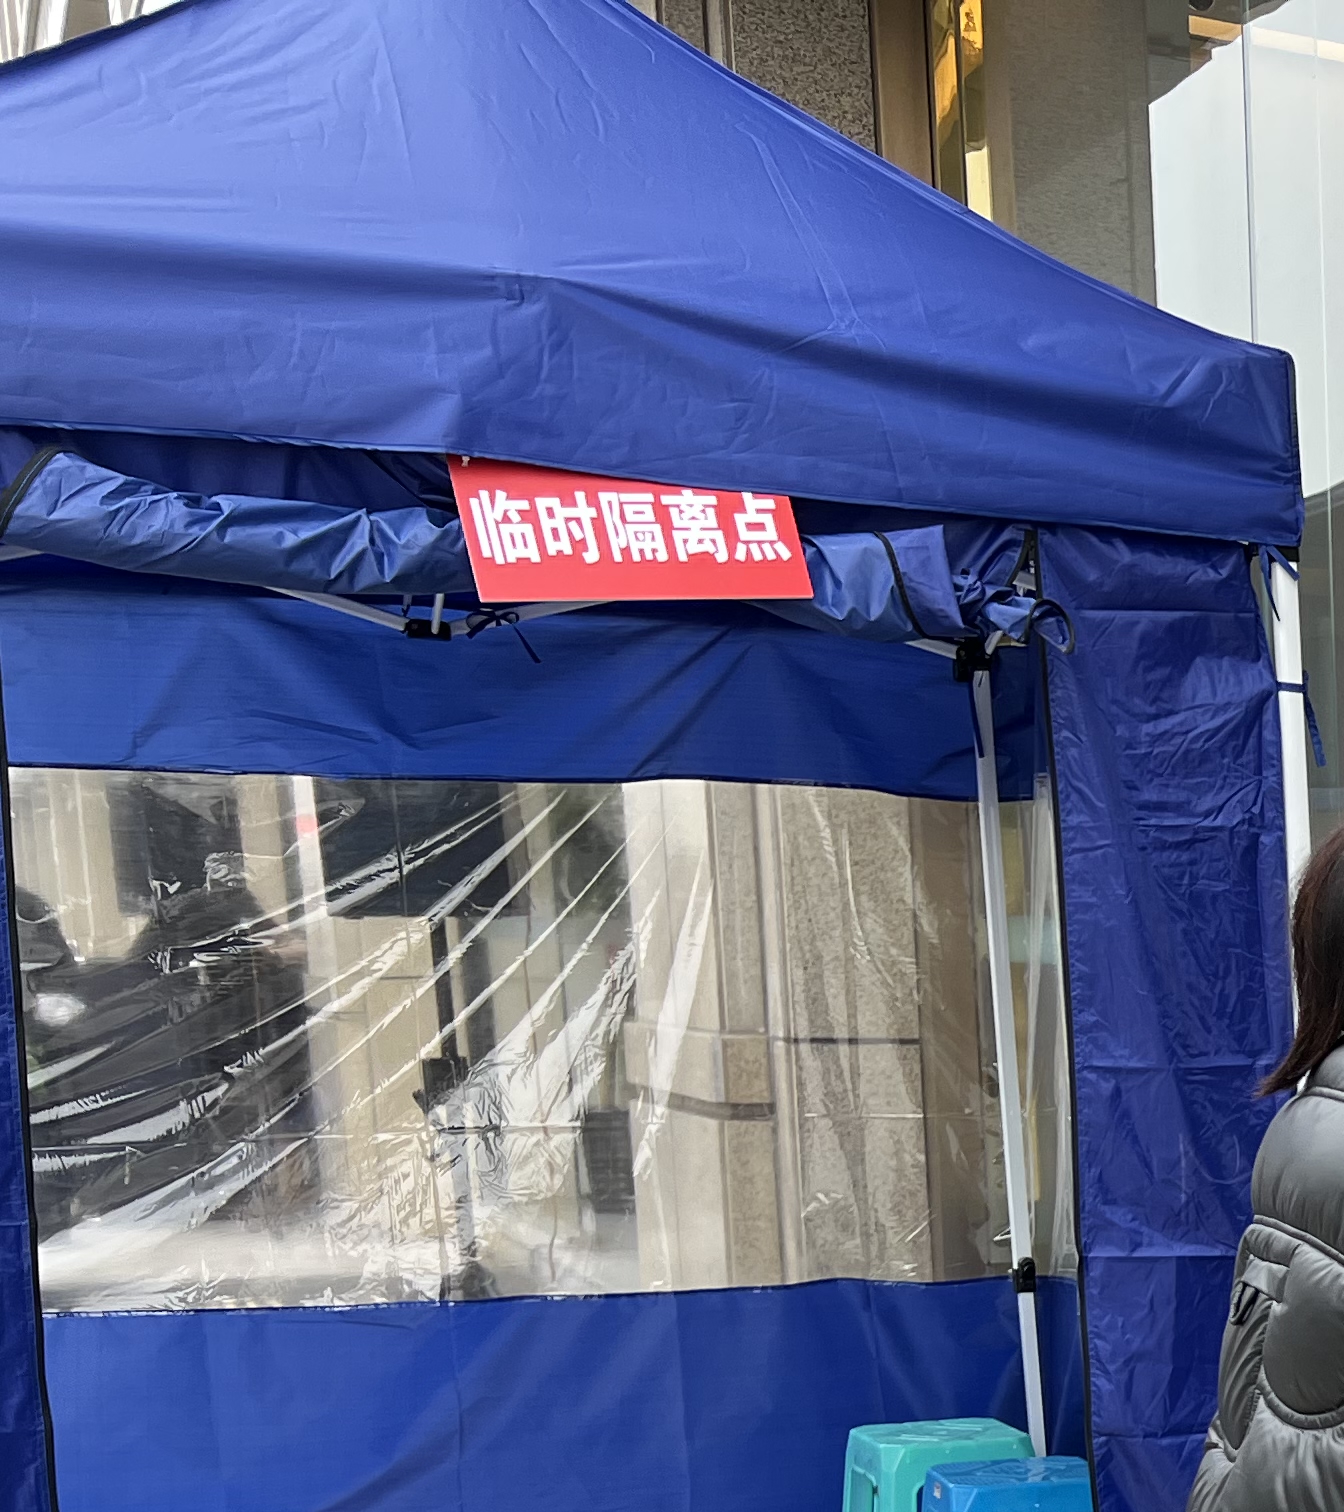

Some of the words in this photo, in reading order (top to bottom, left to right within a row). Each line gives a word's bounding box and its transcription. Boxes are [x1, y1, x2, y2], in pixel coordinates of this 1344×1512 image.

[469, 489, 792, 565] 临时隔离点
